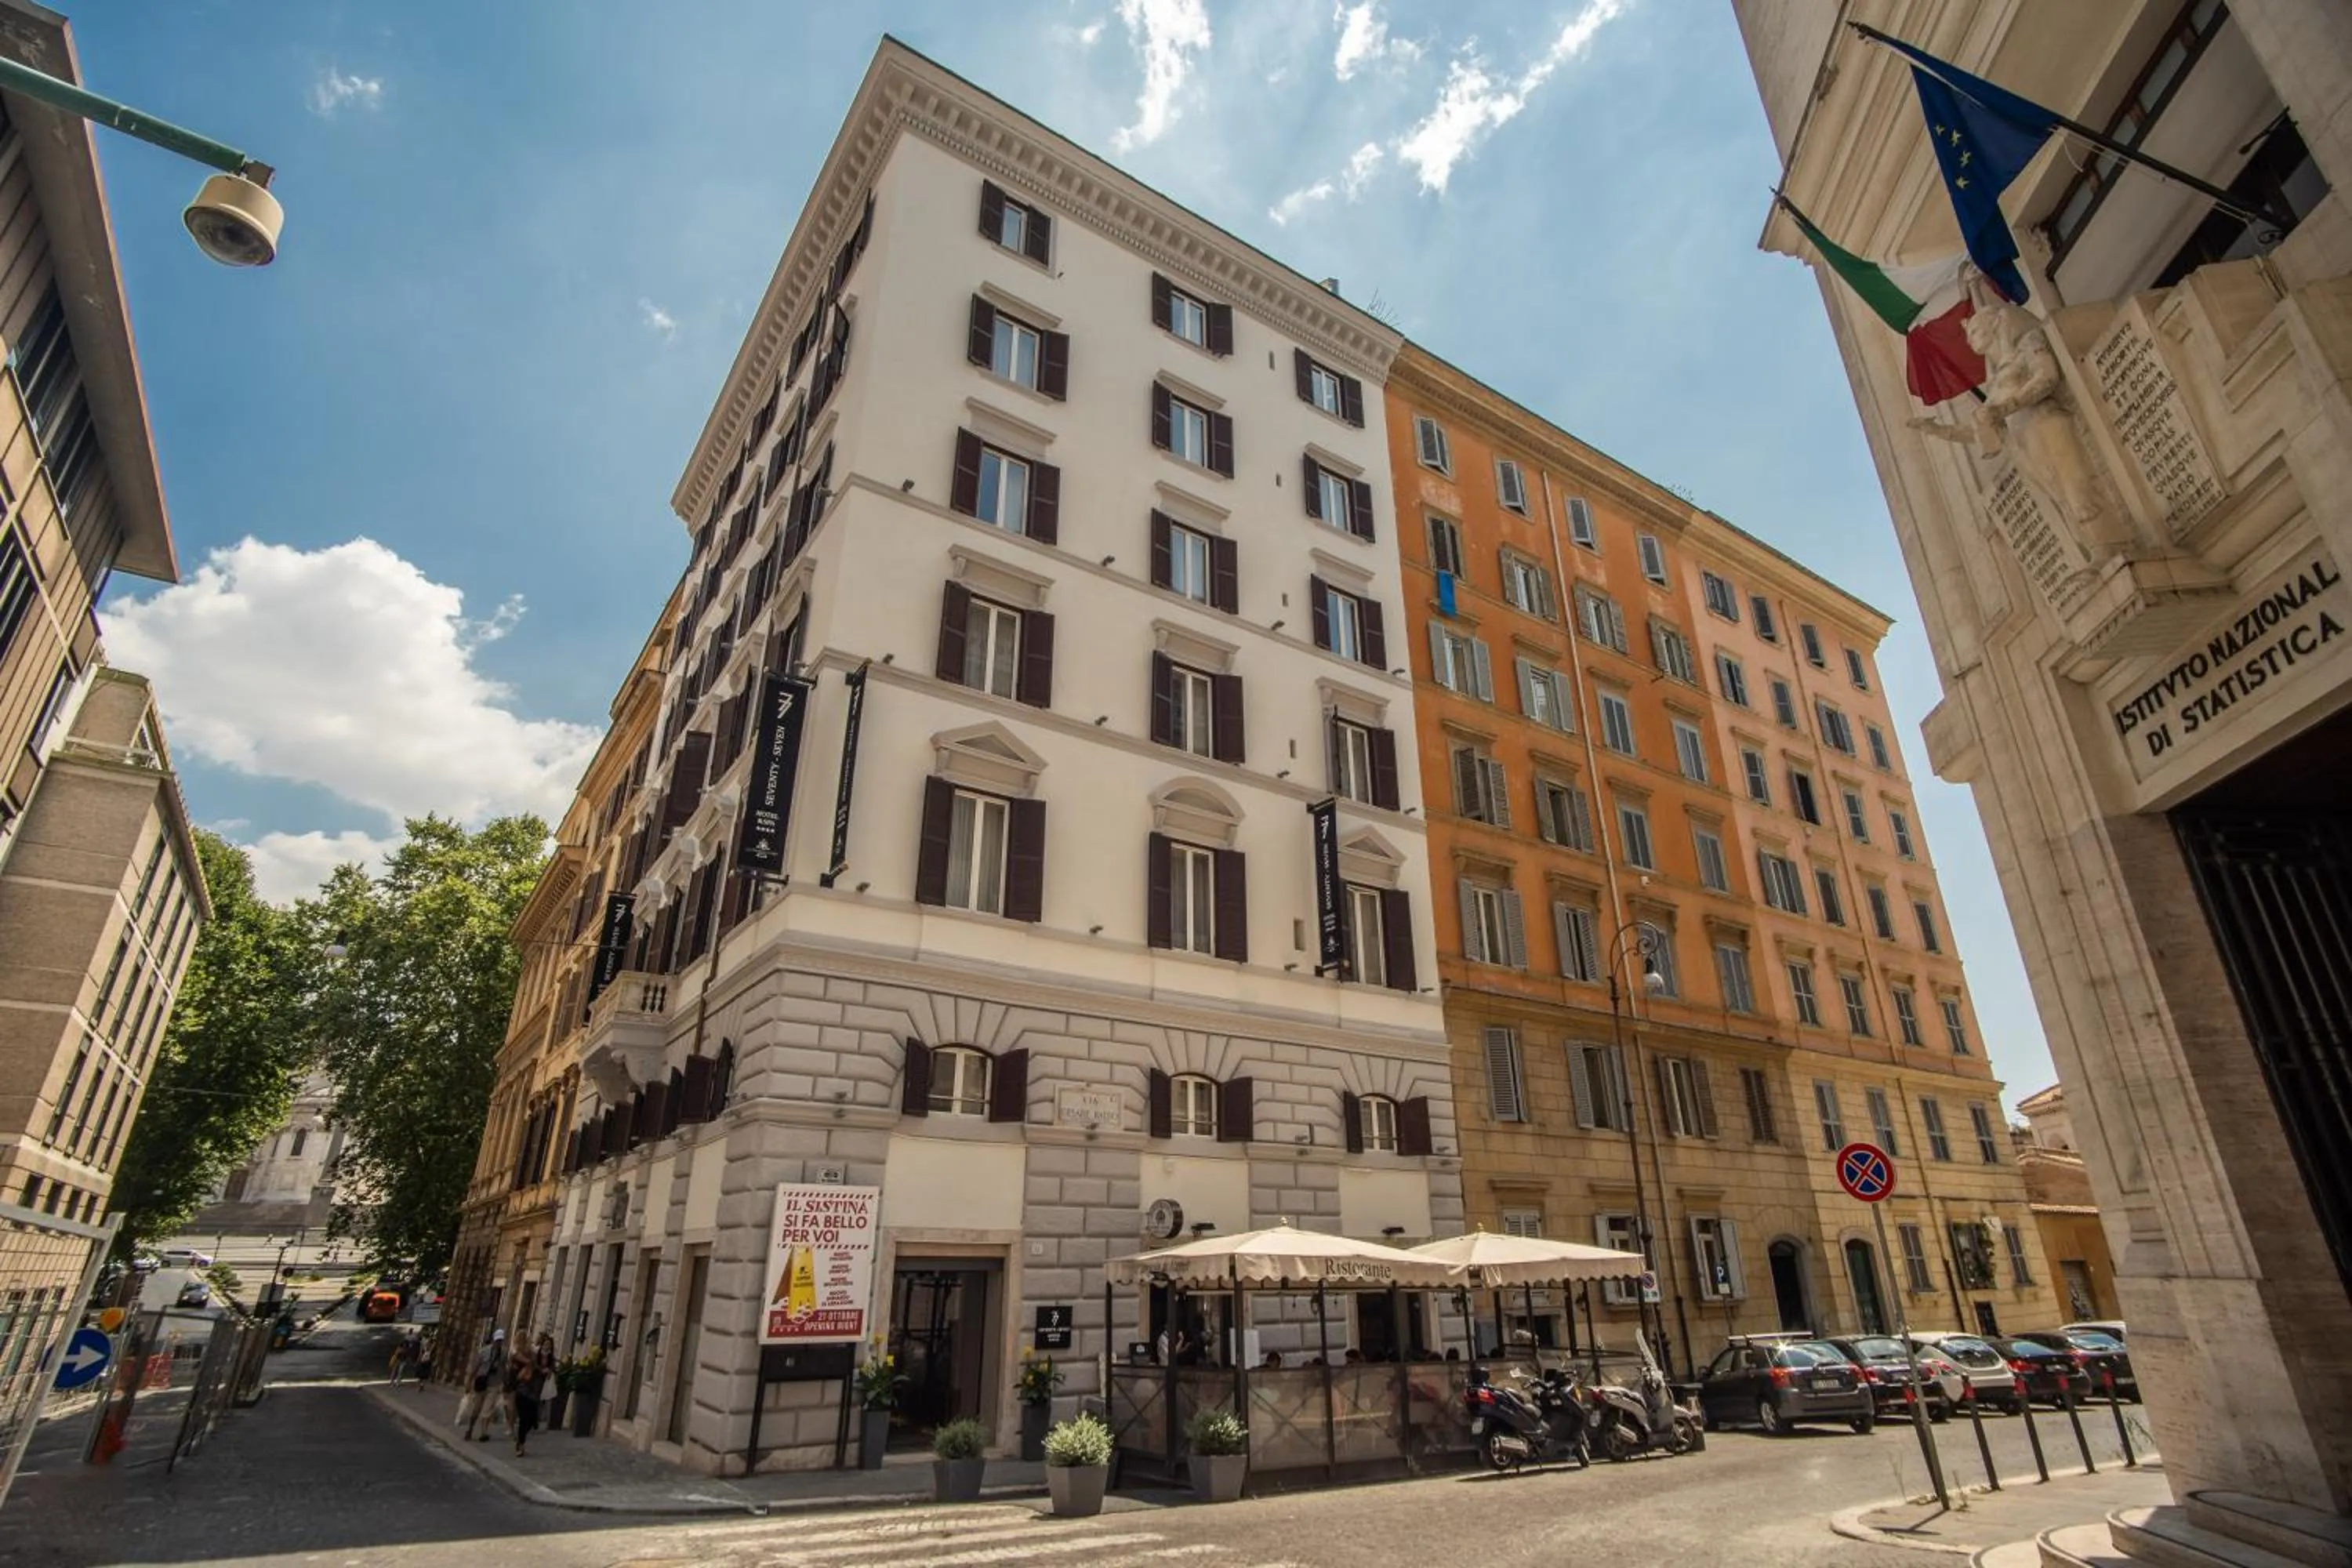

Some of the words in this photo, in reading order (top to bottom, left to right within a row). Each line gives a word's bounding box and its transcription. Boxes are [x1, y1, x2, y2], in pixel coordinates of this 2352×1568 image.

[2114, 652, 2209, 735] ISTITVTO
[2206, 561, 2341, 667] NAZIONAL
[2146, 723, 2174, 757] DI
[2180, 611, 2345, 735] STATISTICA
[772, 724, 785, 757] SEVEN
[765, 760, 780, 806] SEVENTY
[786, 1200, 801, 1211] IL
[804, 1200, 868, 1214] SISTINA
[784, 1214, 798, 1227] SI
[801, 1214, 819, 1228] FA
[824, 1215, 867, 1229] BELLO
[782, 1229, 809, 1243] PER
[813, 1229, 839, 1243] VOI
[1325, 1258, 1392, 1279] Ristorante
[1716, 1266, 1724, 1283] P
